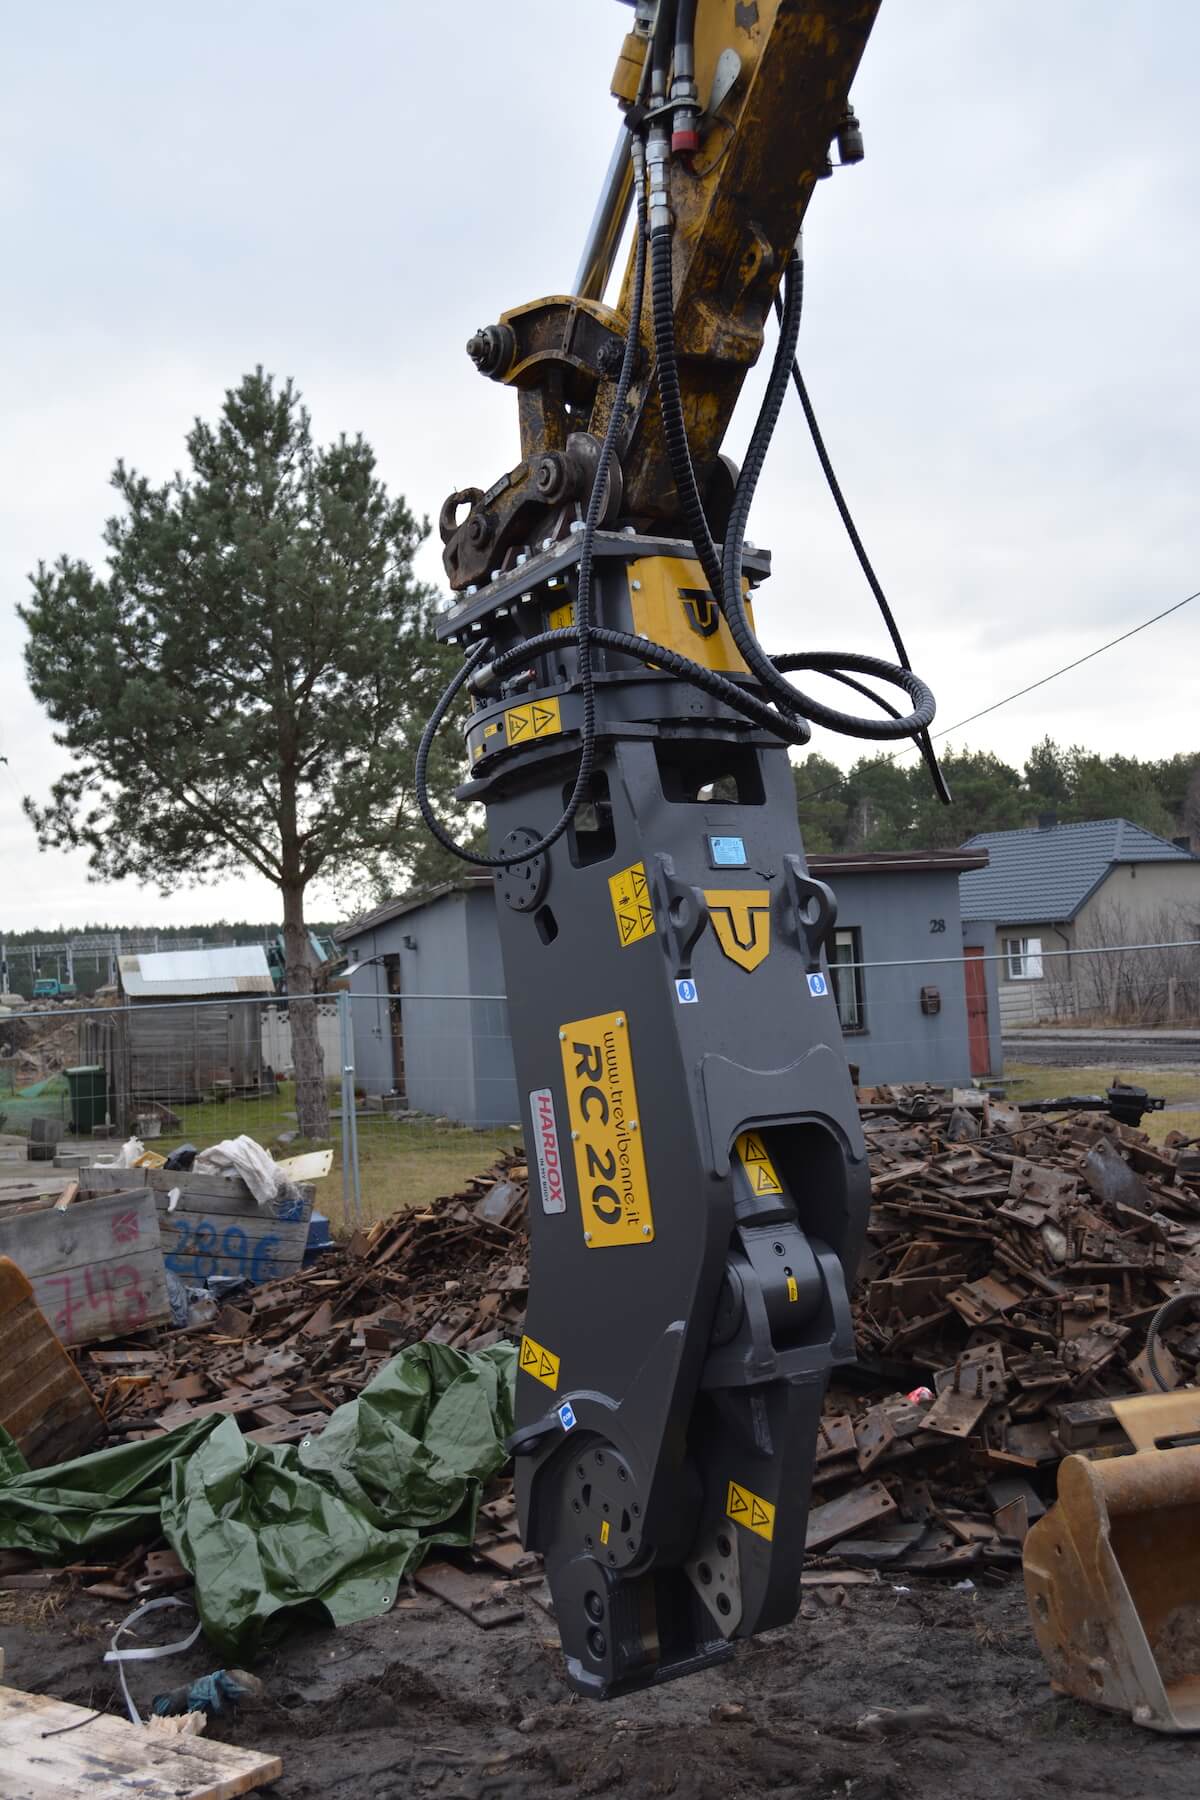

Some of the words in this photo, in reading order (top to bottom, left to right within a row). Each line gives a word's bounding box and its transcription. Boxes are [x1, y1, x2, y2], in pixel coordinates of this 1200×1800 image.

[929, 919, 946, 934] 28
[572, 1041, 610, 1127] RC
[537, 1096, 562, 1202] HARDOX
[603, 1031, 640, 1226] www.trevibenne.it
[585, 1143, 622, 1225] 20
